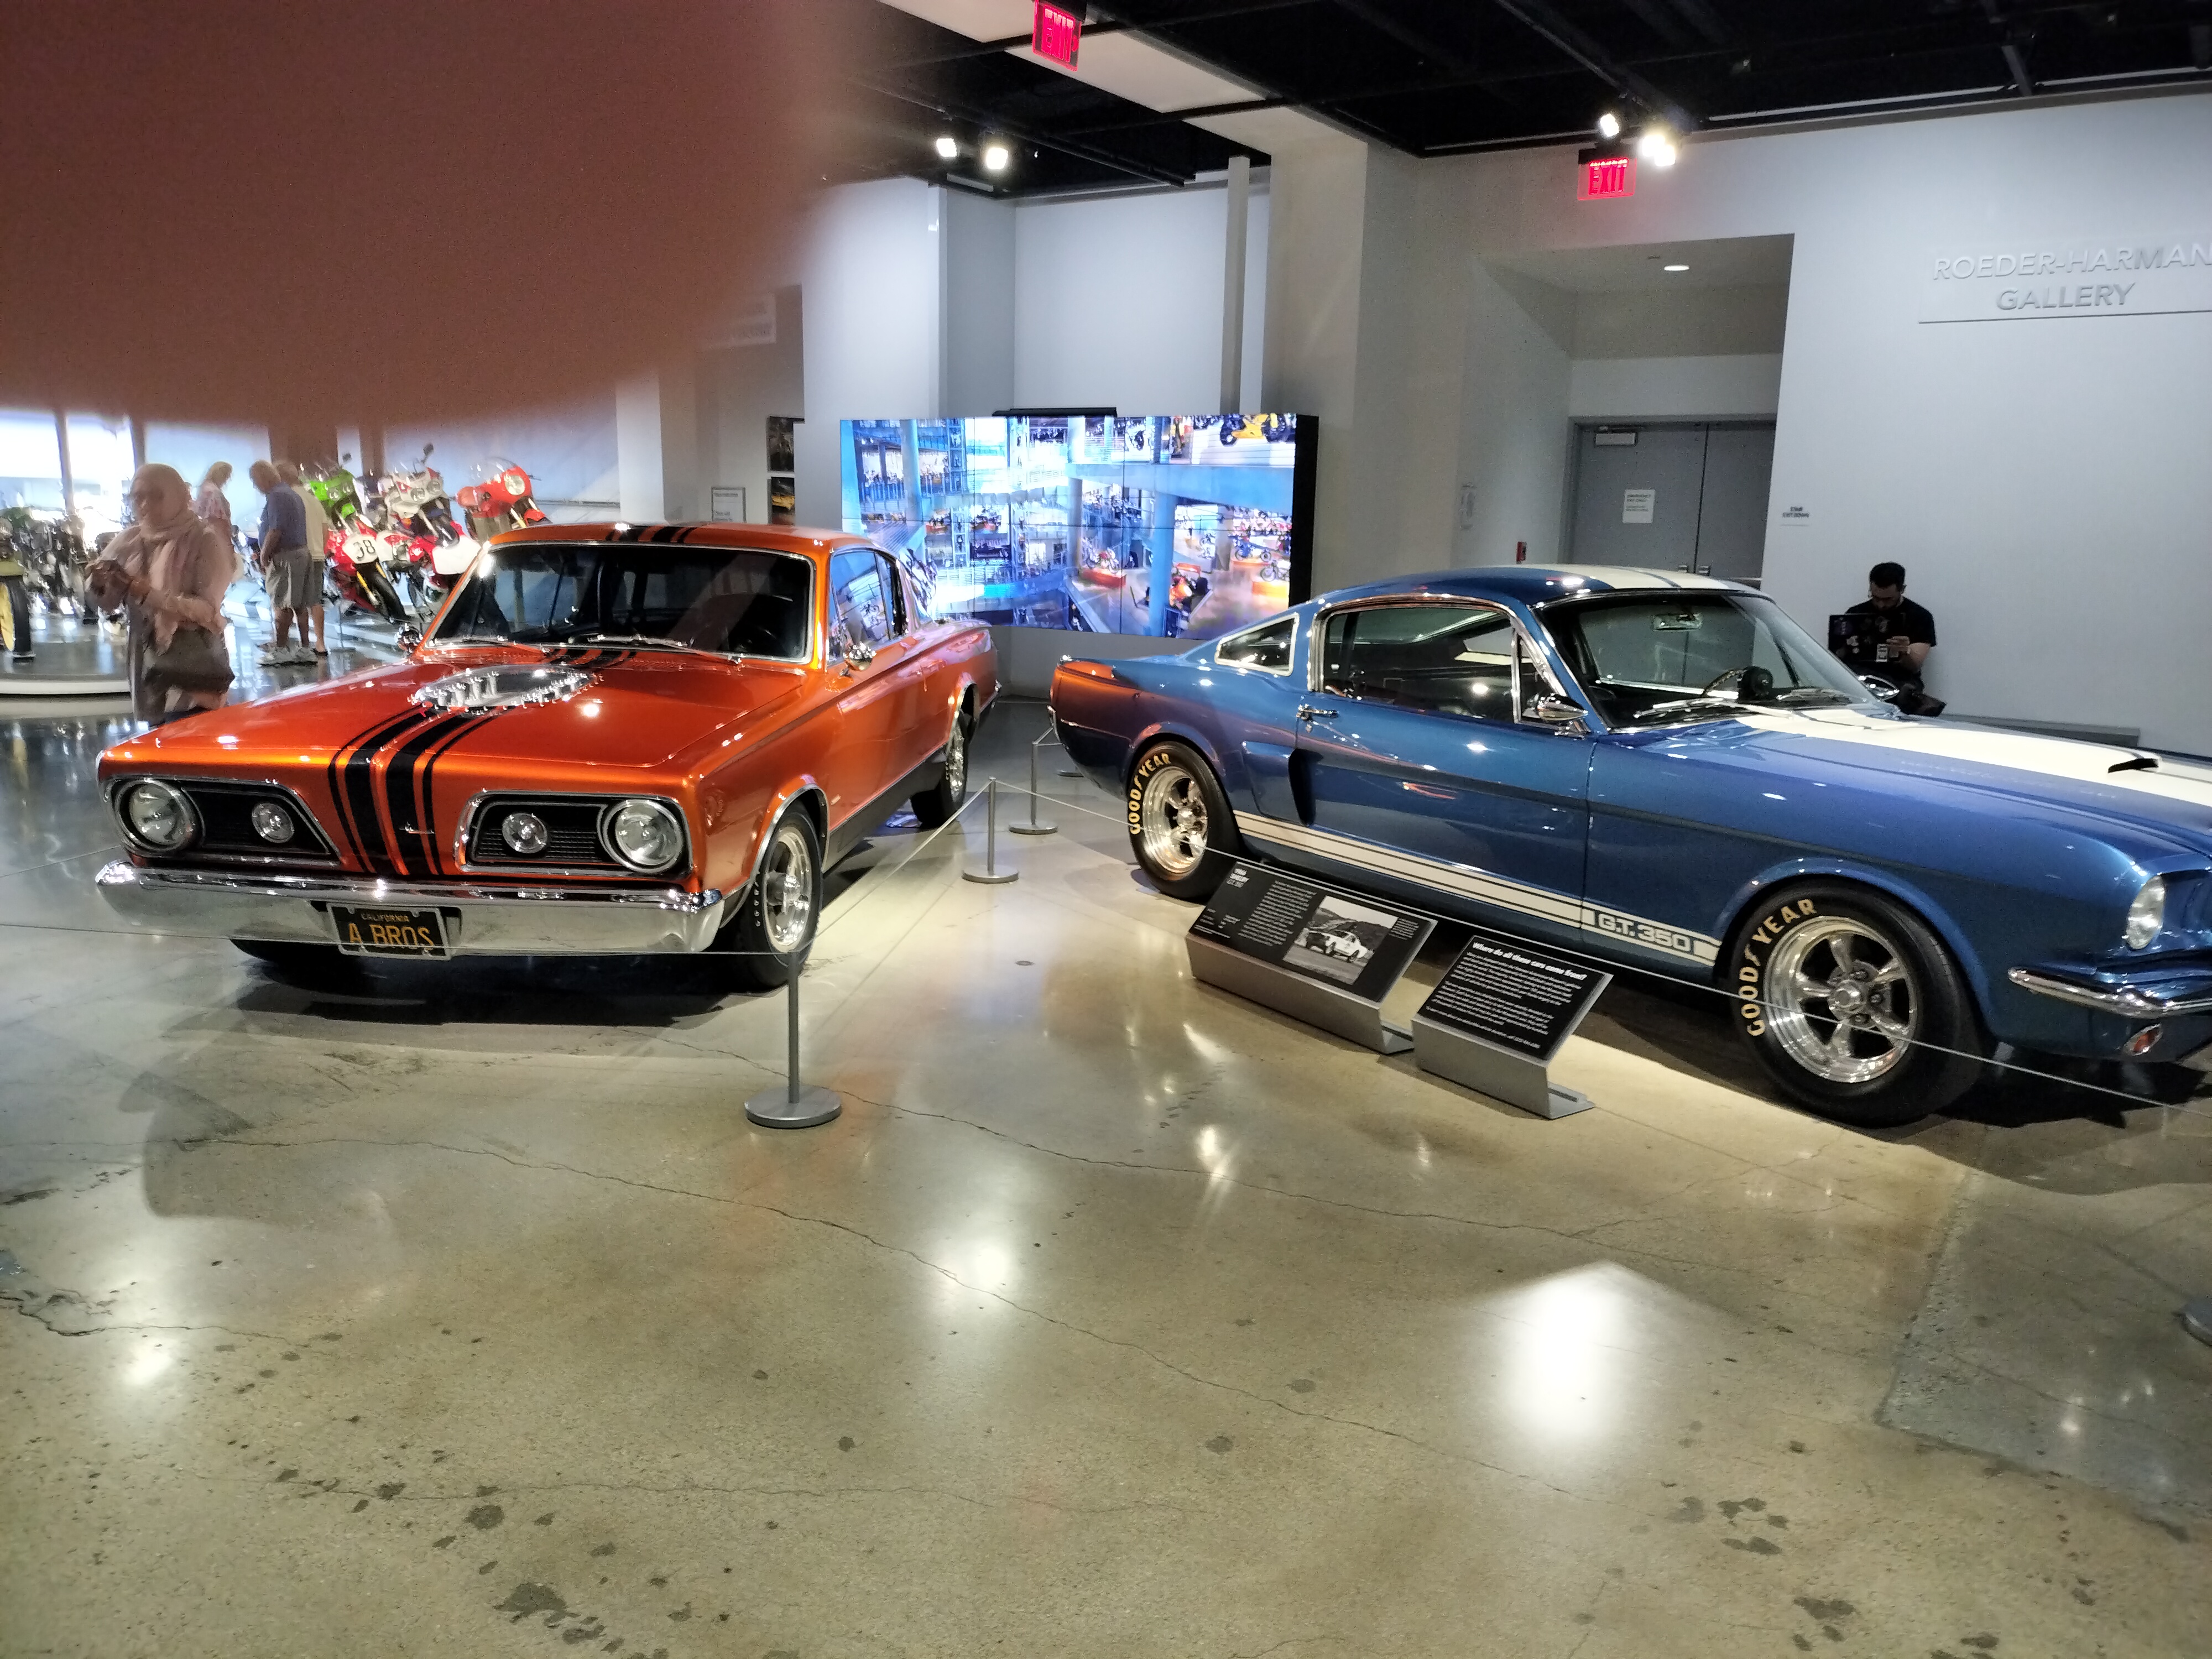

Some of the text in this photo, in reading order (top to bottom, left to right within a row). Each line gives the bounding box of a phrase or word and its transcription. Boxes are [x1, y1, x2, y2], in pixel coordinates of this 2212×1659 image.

[1588, 159, 1628, 195] EXIT
[1934, 243, 2212, 280] ROEDER-HARMAN
[1996, 282, 2136, 310] GALLERY
[1129, 753, 1171, 834] GOODYEAR
[361, 912, 410, 922] CALIFORNIA
[348, 922, 434, 951] A BROS
[1637, 924, 1692, 952] 350
[1473, 942, 1494, 953] Where
[1512, 954, 1531, 964] these
[1545, 966, 1565, 974] come
[1564, 969, 1588, 980] from?
[1738, 898, 1818, 1037] GOODYEAR
